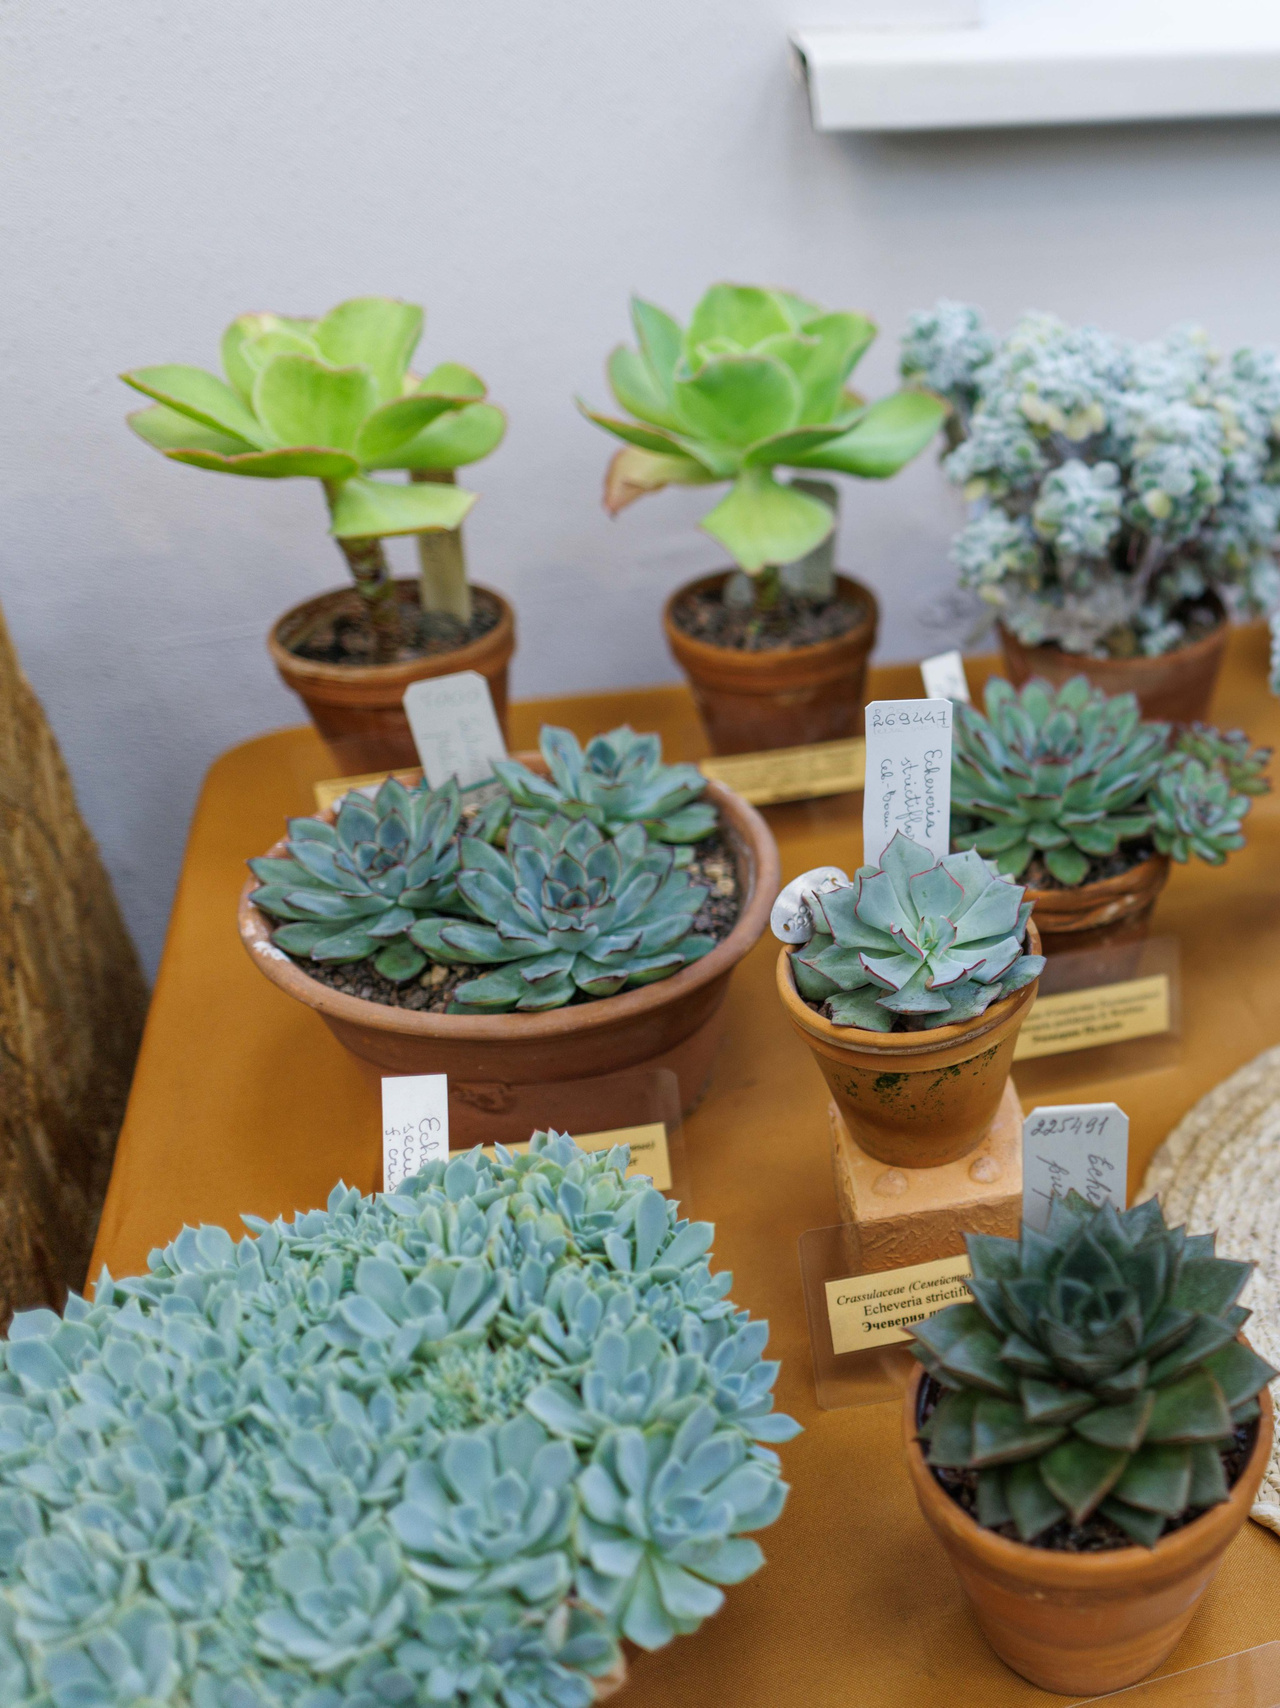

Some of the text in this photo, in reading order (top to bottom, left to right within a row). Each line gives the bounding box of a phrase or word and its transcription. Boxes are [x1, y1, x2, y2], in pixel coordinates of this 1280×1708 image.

[924, 749, 943, 838] Echeveria
[418, 1117, 441, 1169] Eche
[1031, 1116, 1109, 1137] 225491
[388, 1149, 401, 1192] cris
[403, 1124, 415, 1177] secu
[1086, 1154, 1114, 1203] Eche
[836, 1272, 972, 1306] Crassulaceae (Семейство
[863, 1297, 923, 1317] Echeveria
[862, 1312, 925, 1333] Эчеверия
